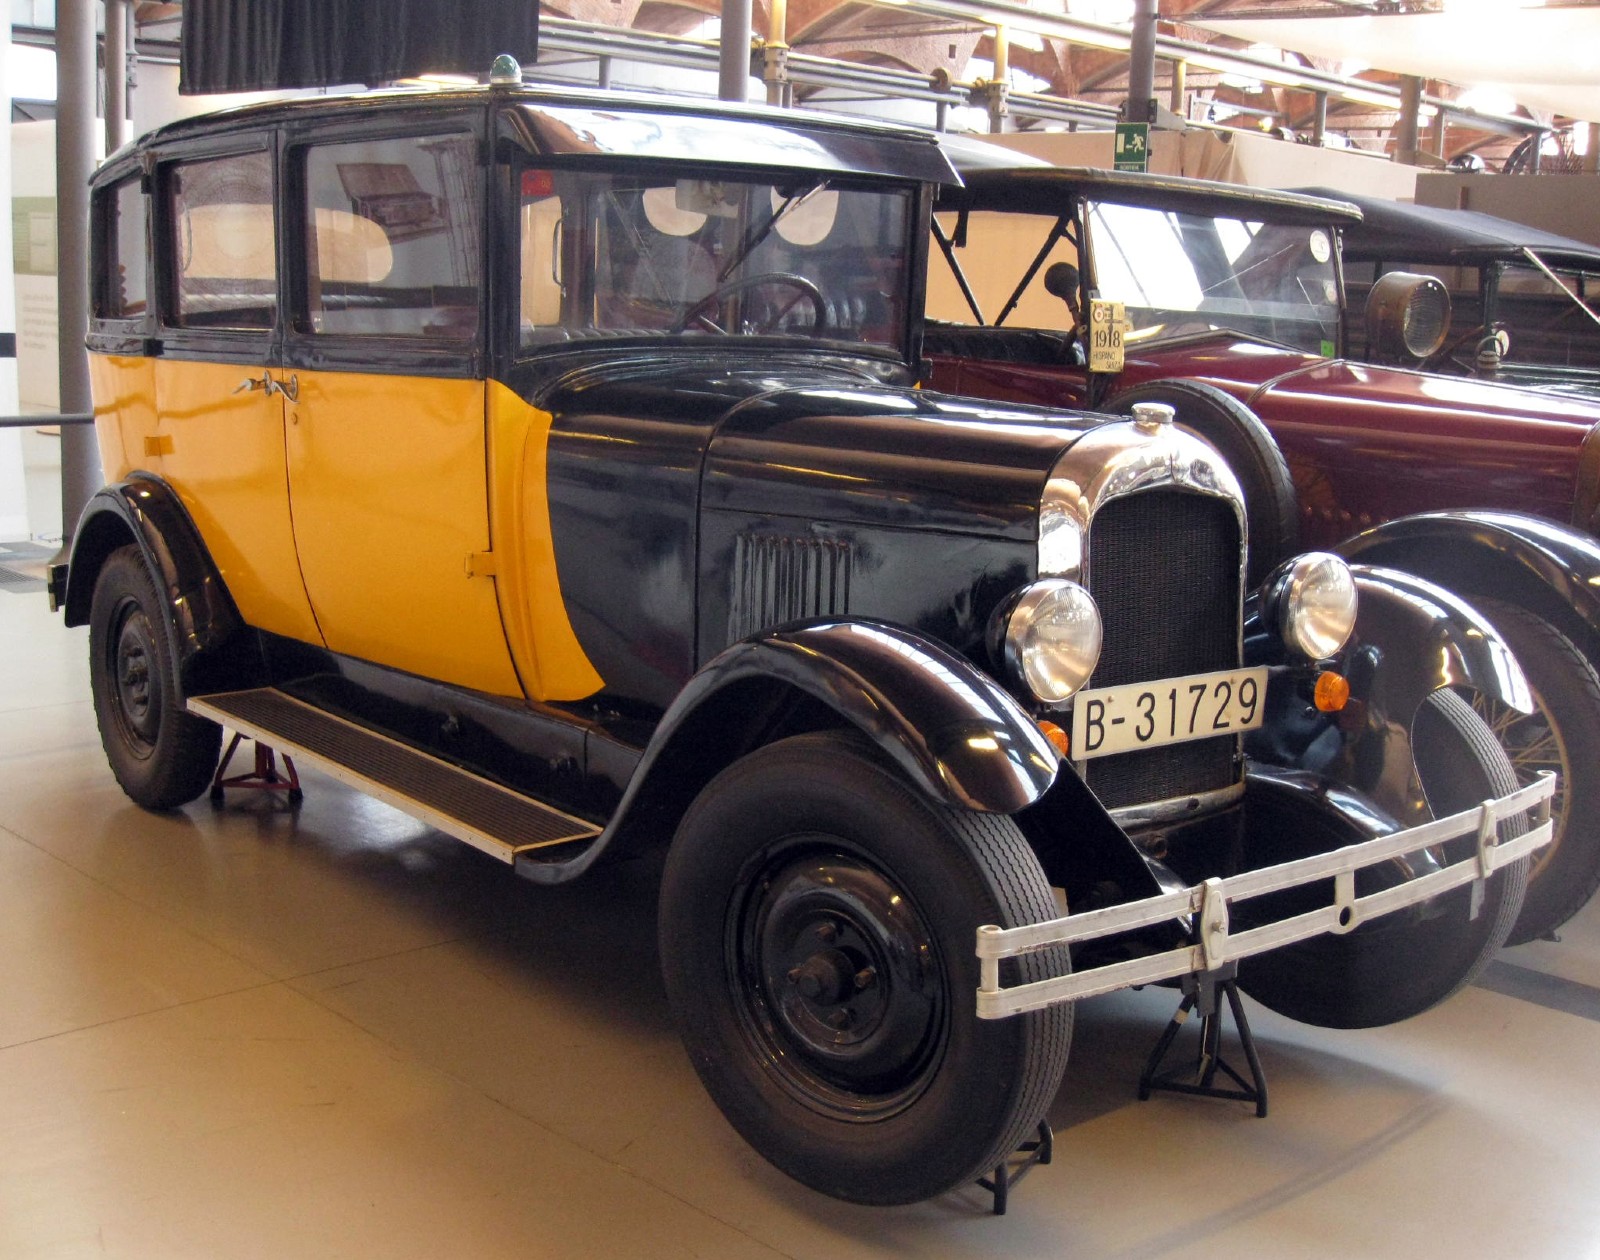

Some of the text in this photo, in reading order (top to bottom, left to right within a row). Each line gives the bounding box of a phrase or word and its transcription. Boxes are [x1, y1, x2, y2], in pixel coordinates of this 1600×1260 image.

[1094, 330, 1120, 348] 1918
[1093, 351, 1115, 360] HISPANO
[1086, 677, 1257, 751] B-31729
